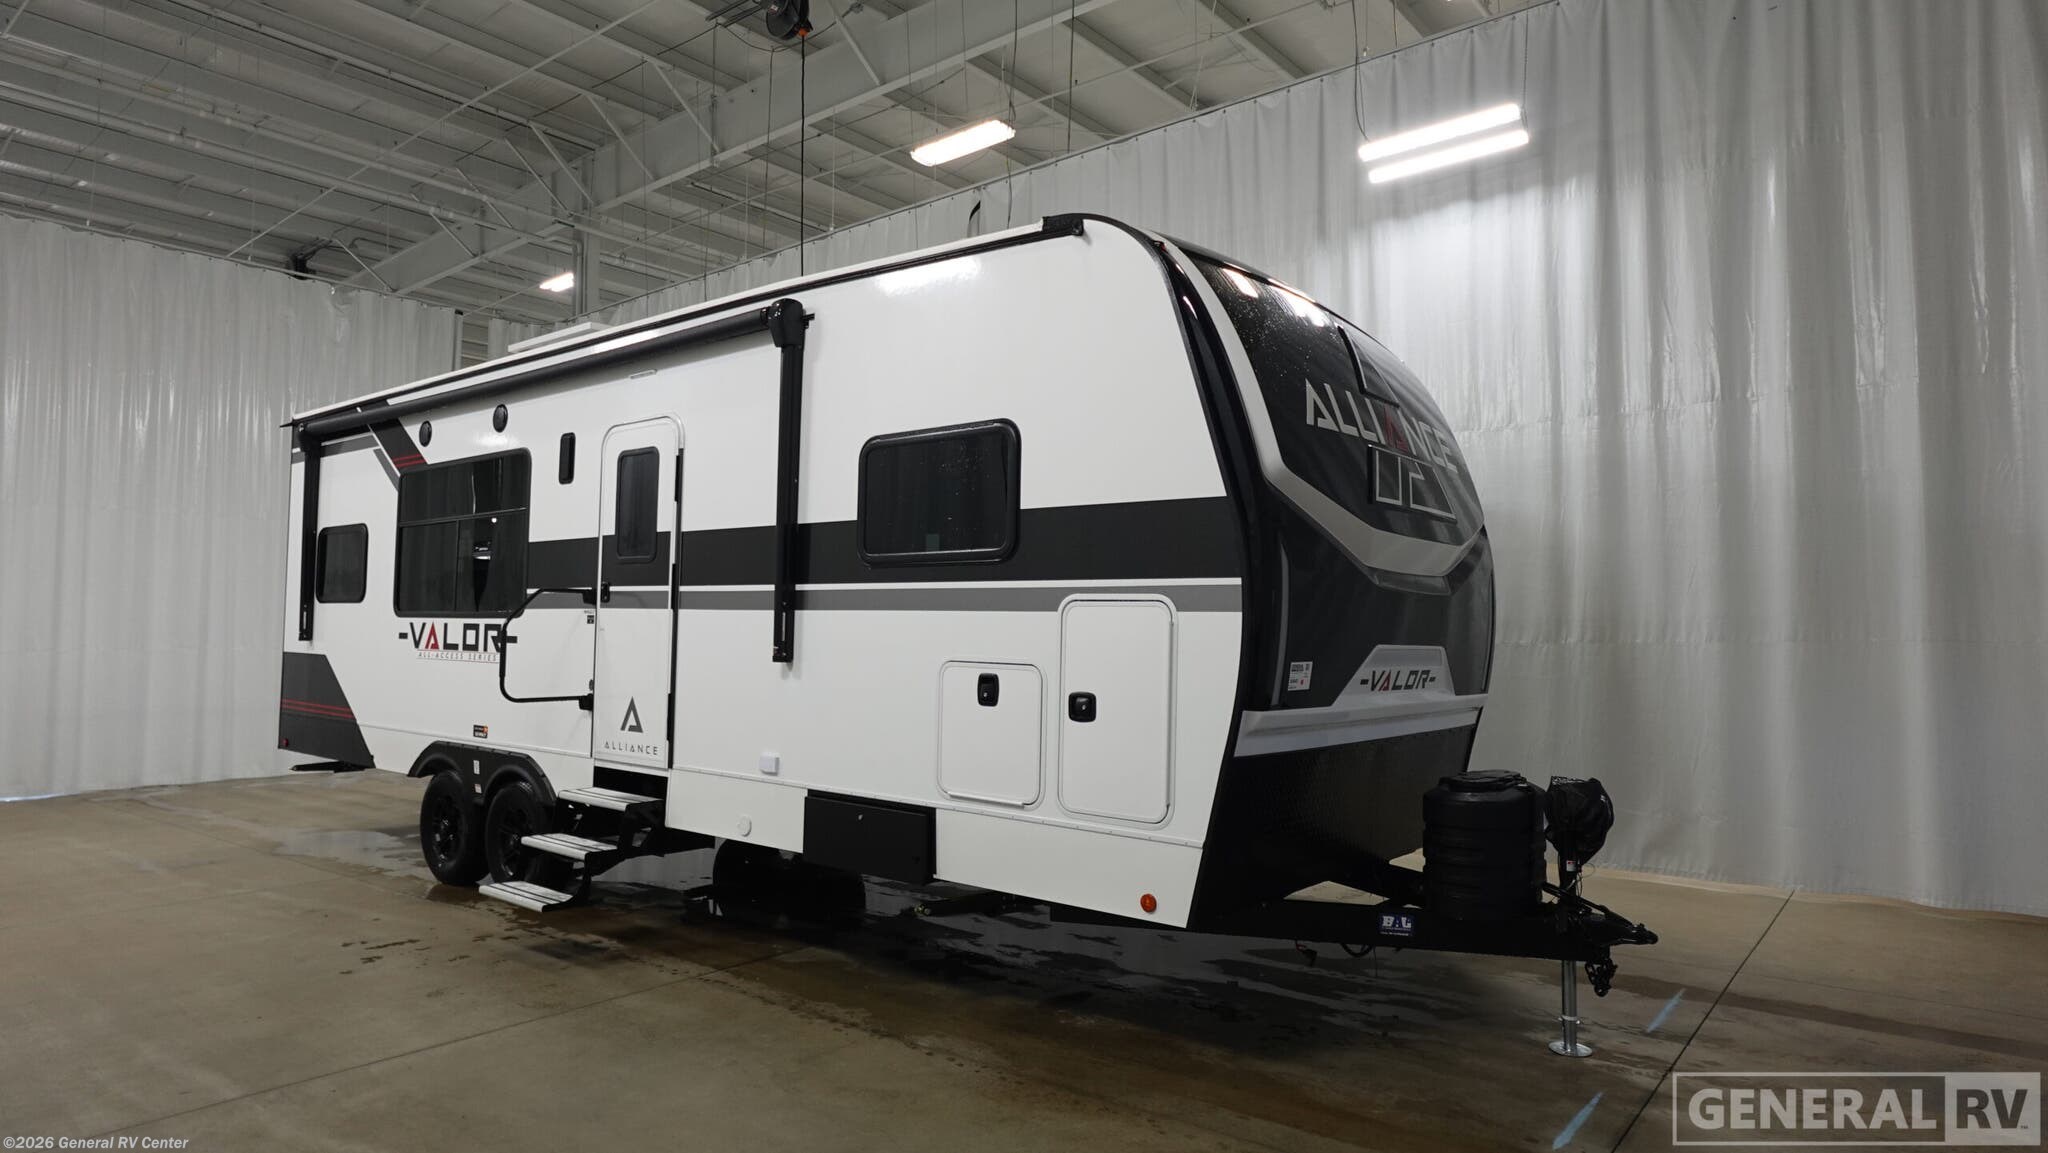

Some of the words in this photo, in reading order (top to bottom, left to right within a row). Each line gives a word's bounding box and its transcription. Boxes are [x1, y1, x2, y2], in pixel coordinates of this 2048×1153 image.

[1305, 378, 1458, 474] ALLIANCE
[468, 652, 497, 662] SERIES
[604, 741, 658, 755] ALLIANCE
